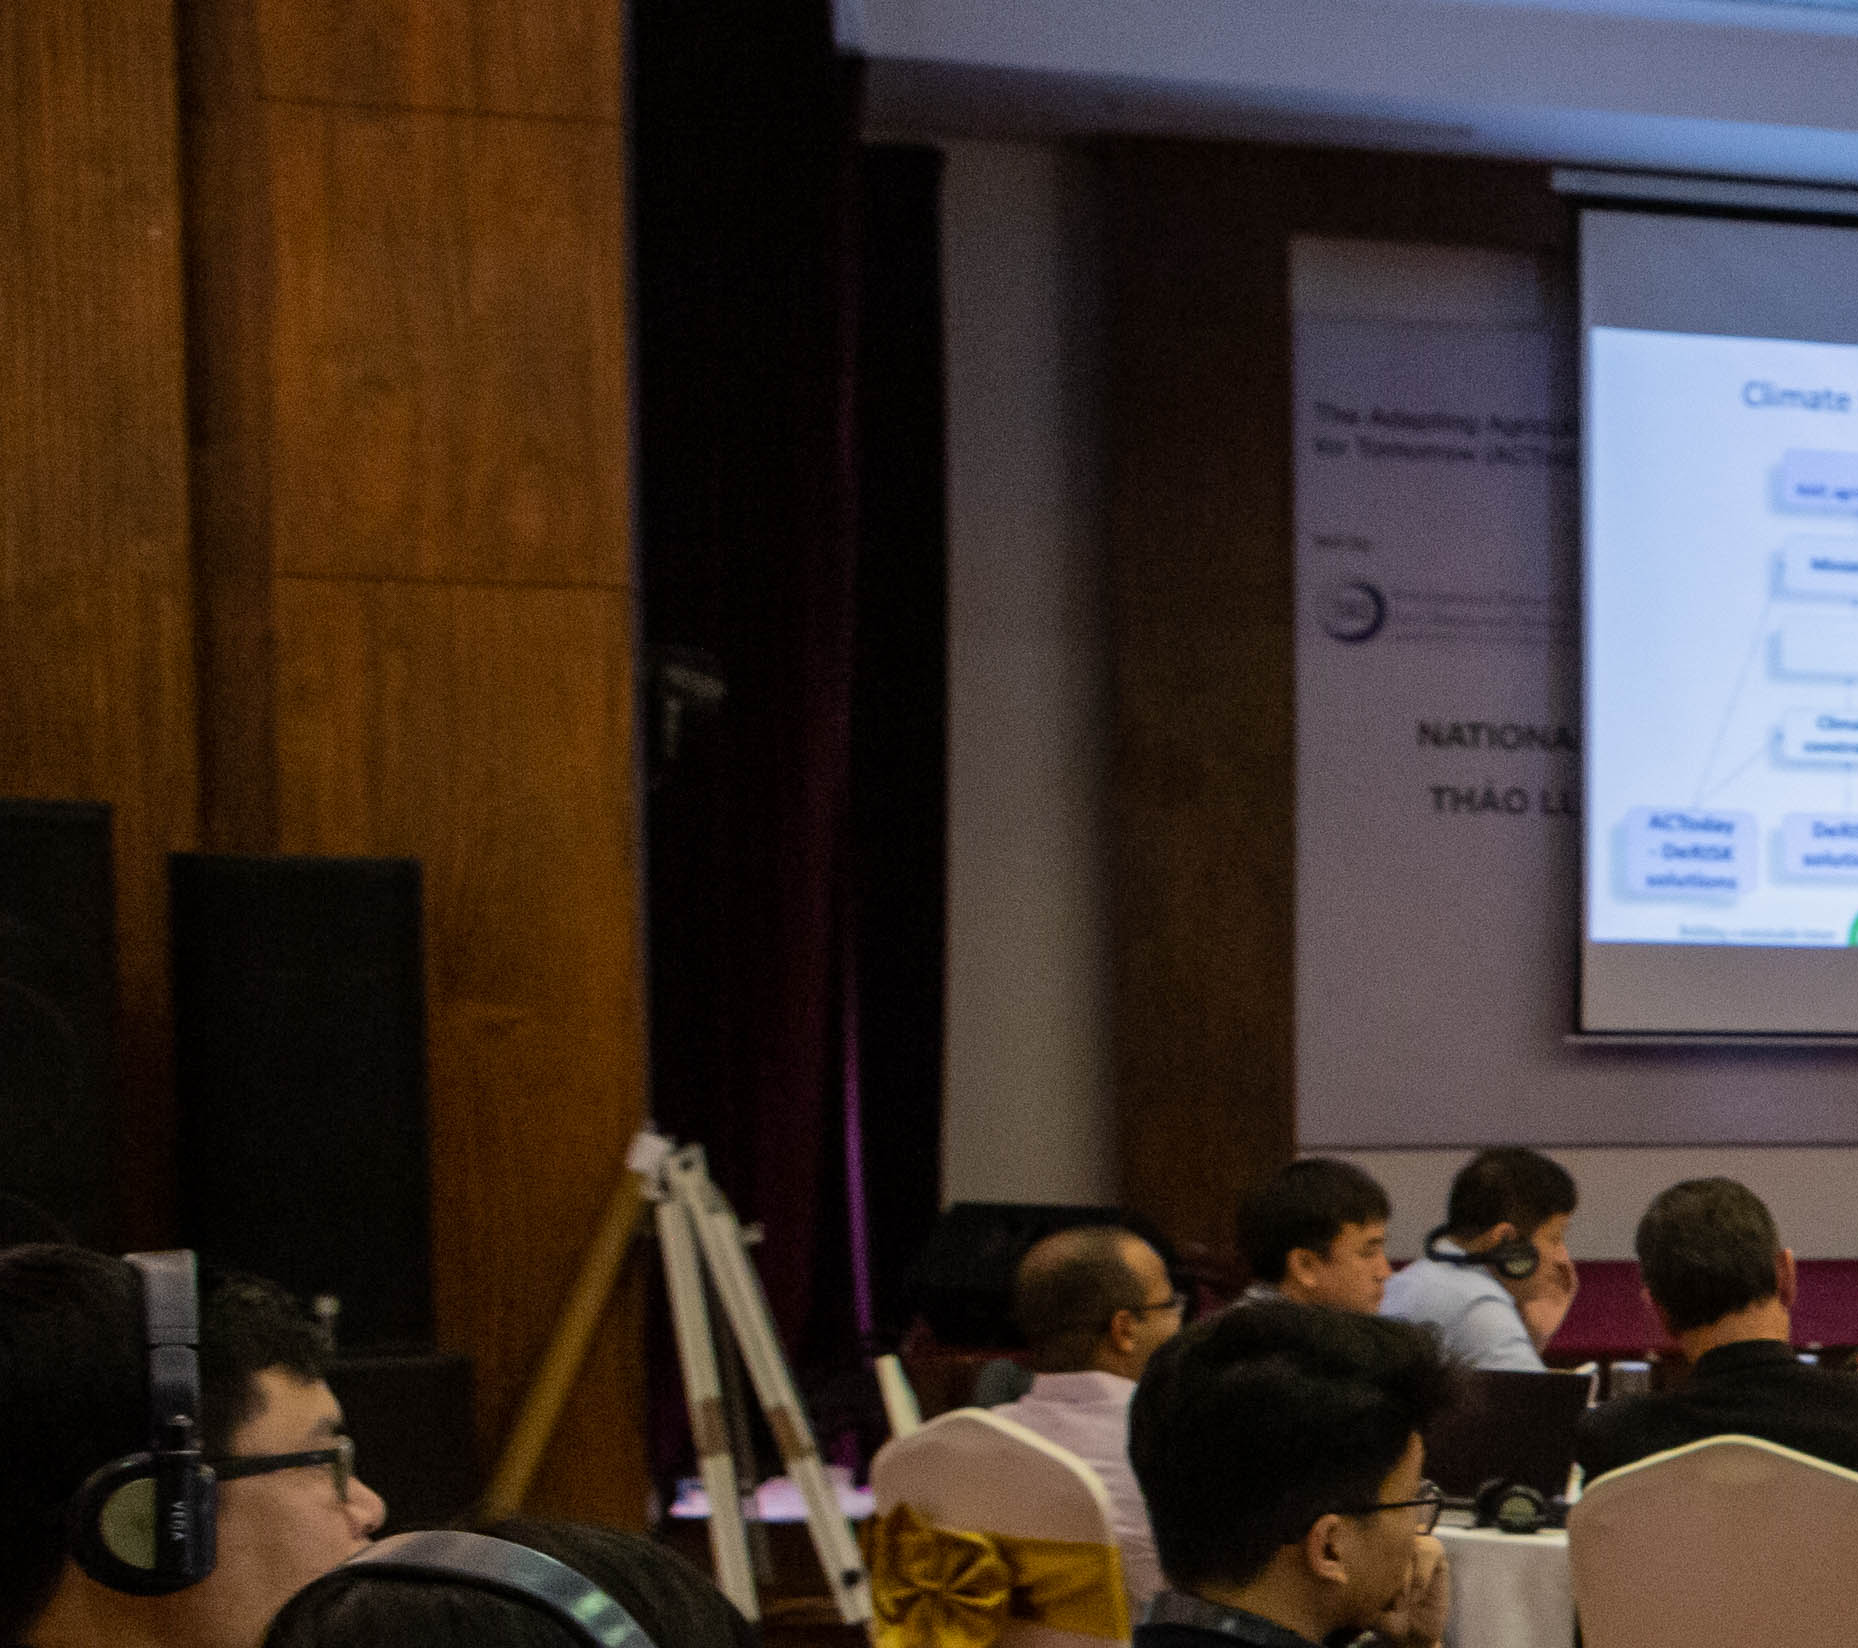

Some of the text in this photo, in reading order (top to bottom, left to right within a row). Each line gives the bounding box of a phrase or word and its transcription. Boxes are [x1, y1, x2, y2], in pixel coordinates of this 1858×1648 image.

[1741, 380, 1850, 413] Climate
[1649, 812, 1734, 835] ACToday
[1661, 842, 1733, 861] DeRISK
[1646, 871, 1737, 889] solutions
